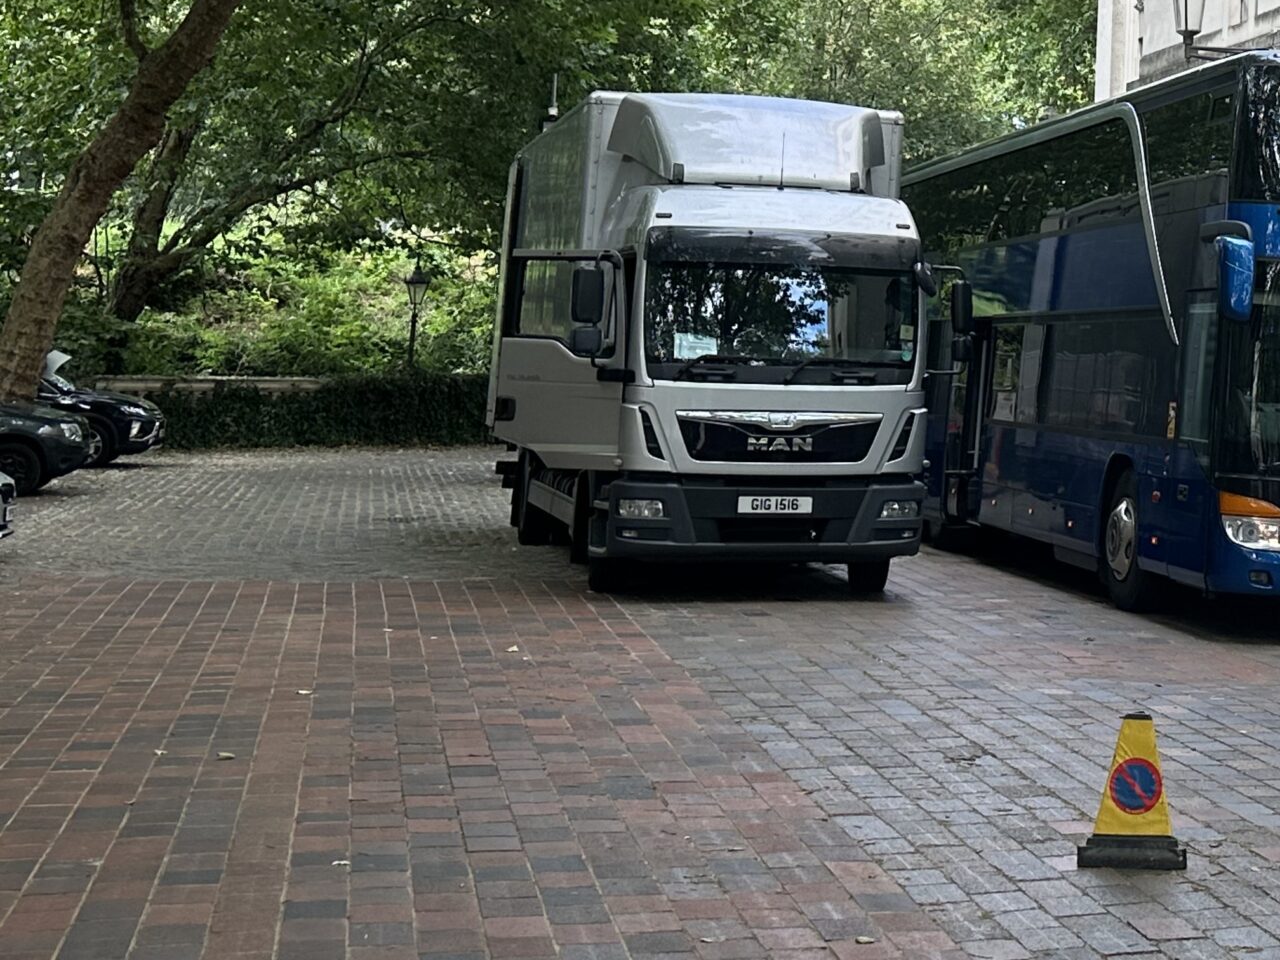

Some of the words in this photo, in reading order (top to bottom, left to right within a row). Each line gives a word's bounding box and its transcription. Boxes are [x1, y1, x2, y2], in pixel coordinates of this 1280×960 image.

[746, 437, 813, 451] MAN
[751, 498, 772, 511] GIG
[775, 498, 799, 511] 1516
